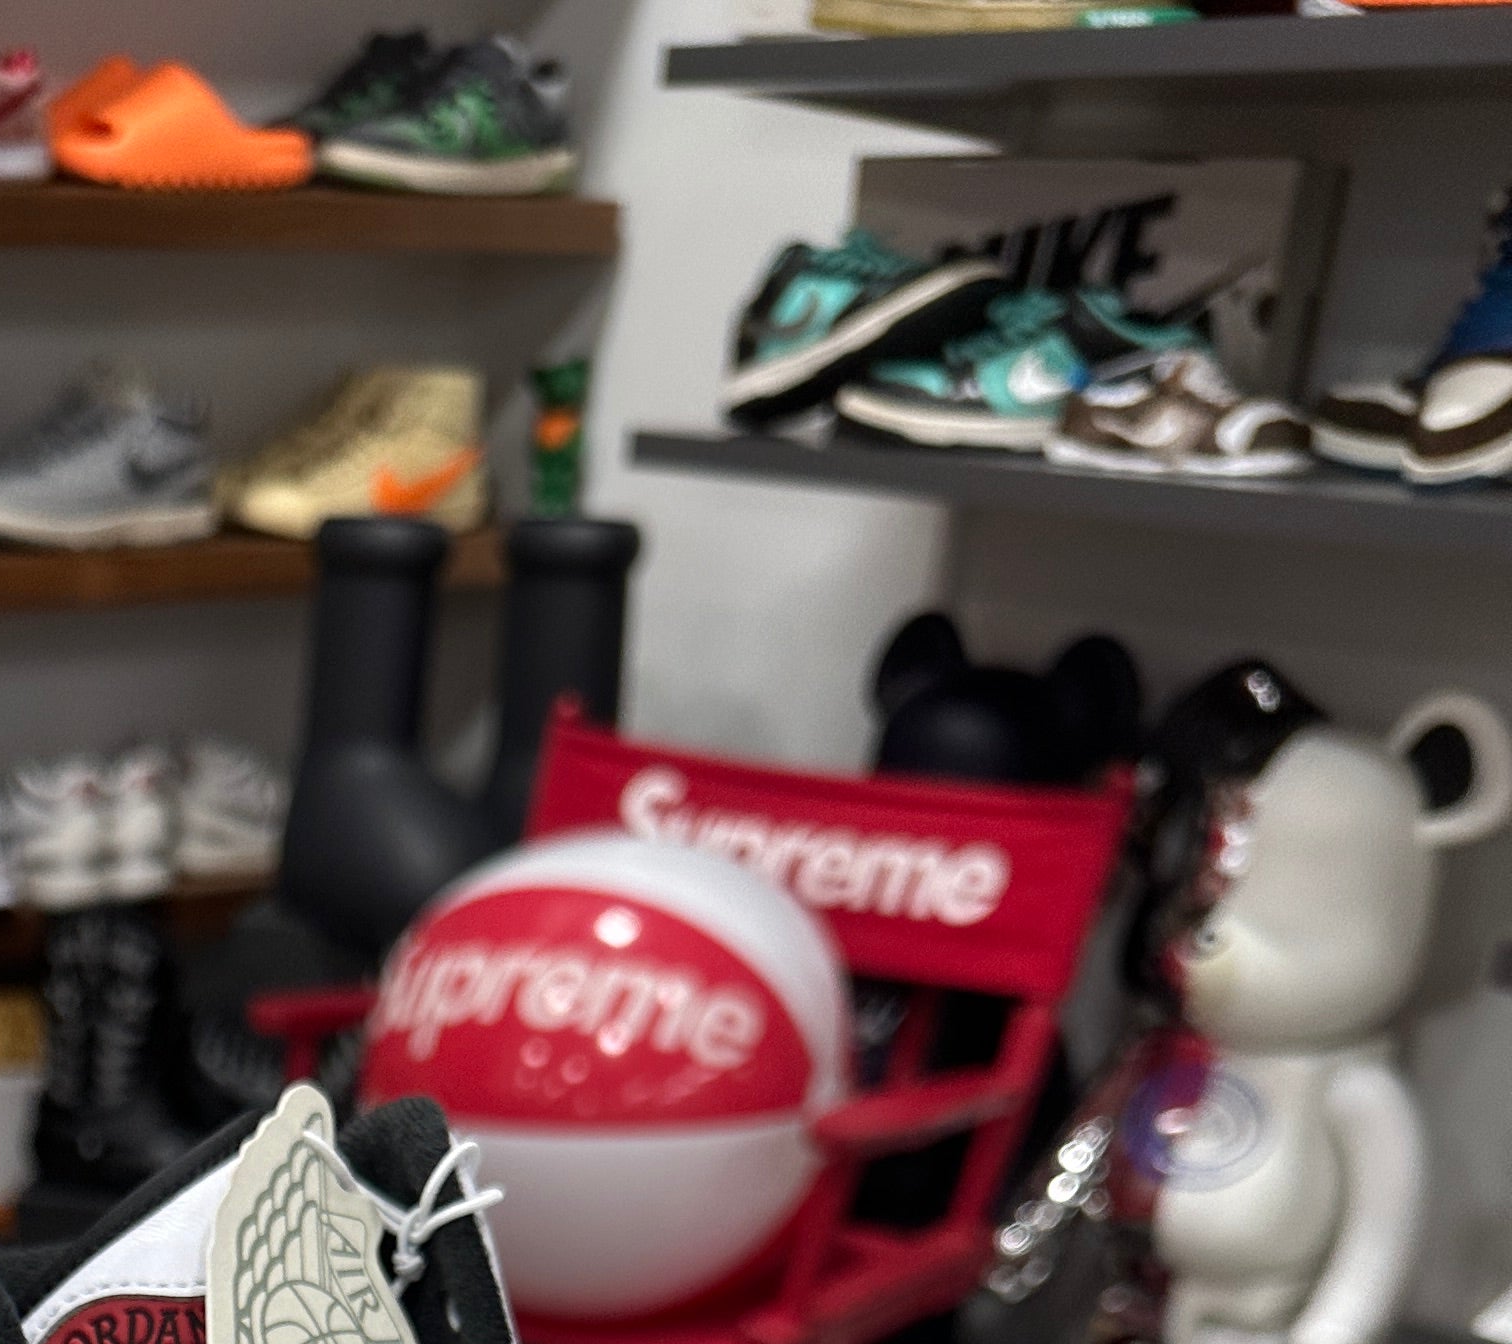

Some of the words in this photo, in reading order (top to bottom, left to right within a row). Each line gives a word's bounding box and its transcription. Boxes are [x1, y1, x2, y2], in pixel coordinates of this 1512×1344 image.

[940, 190, 1178, 298] IKE
[370, 938, 768, 1070] upreme
[330, 1226, 380, 1322] AIR
